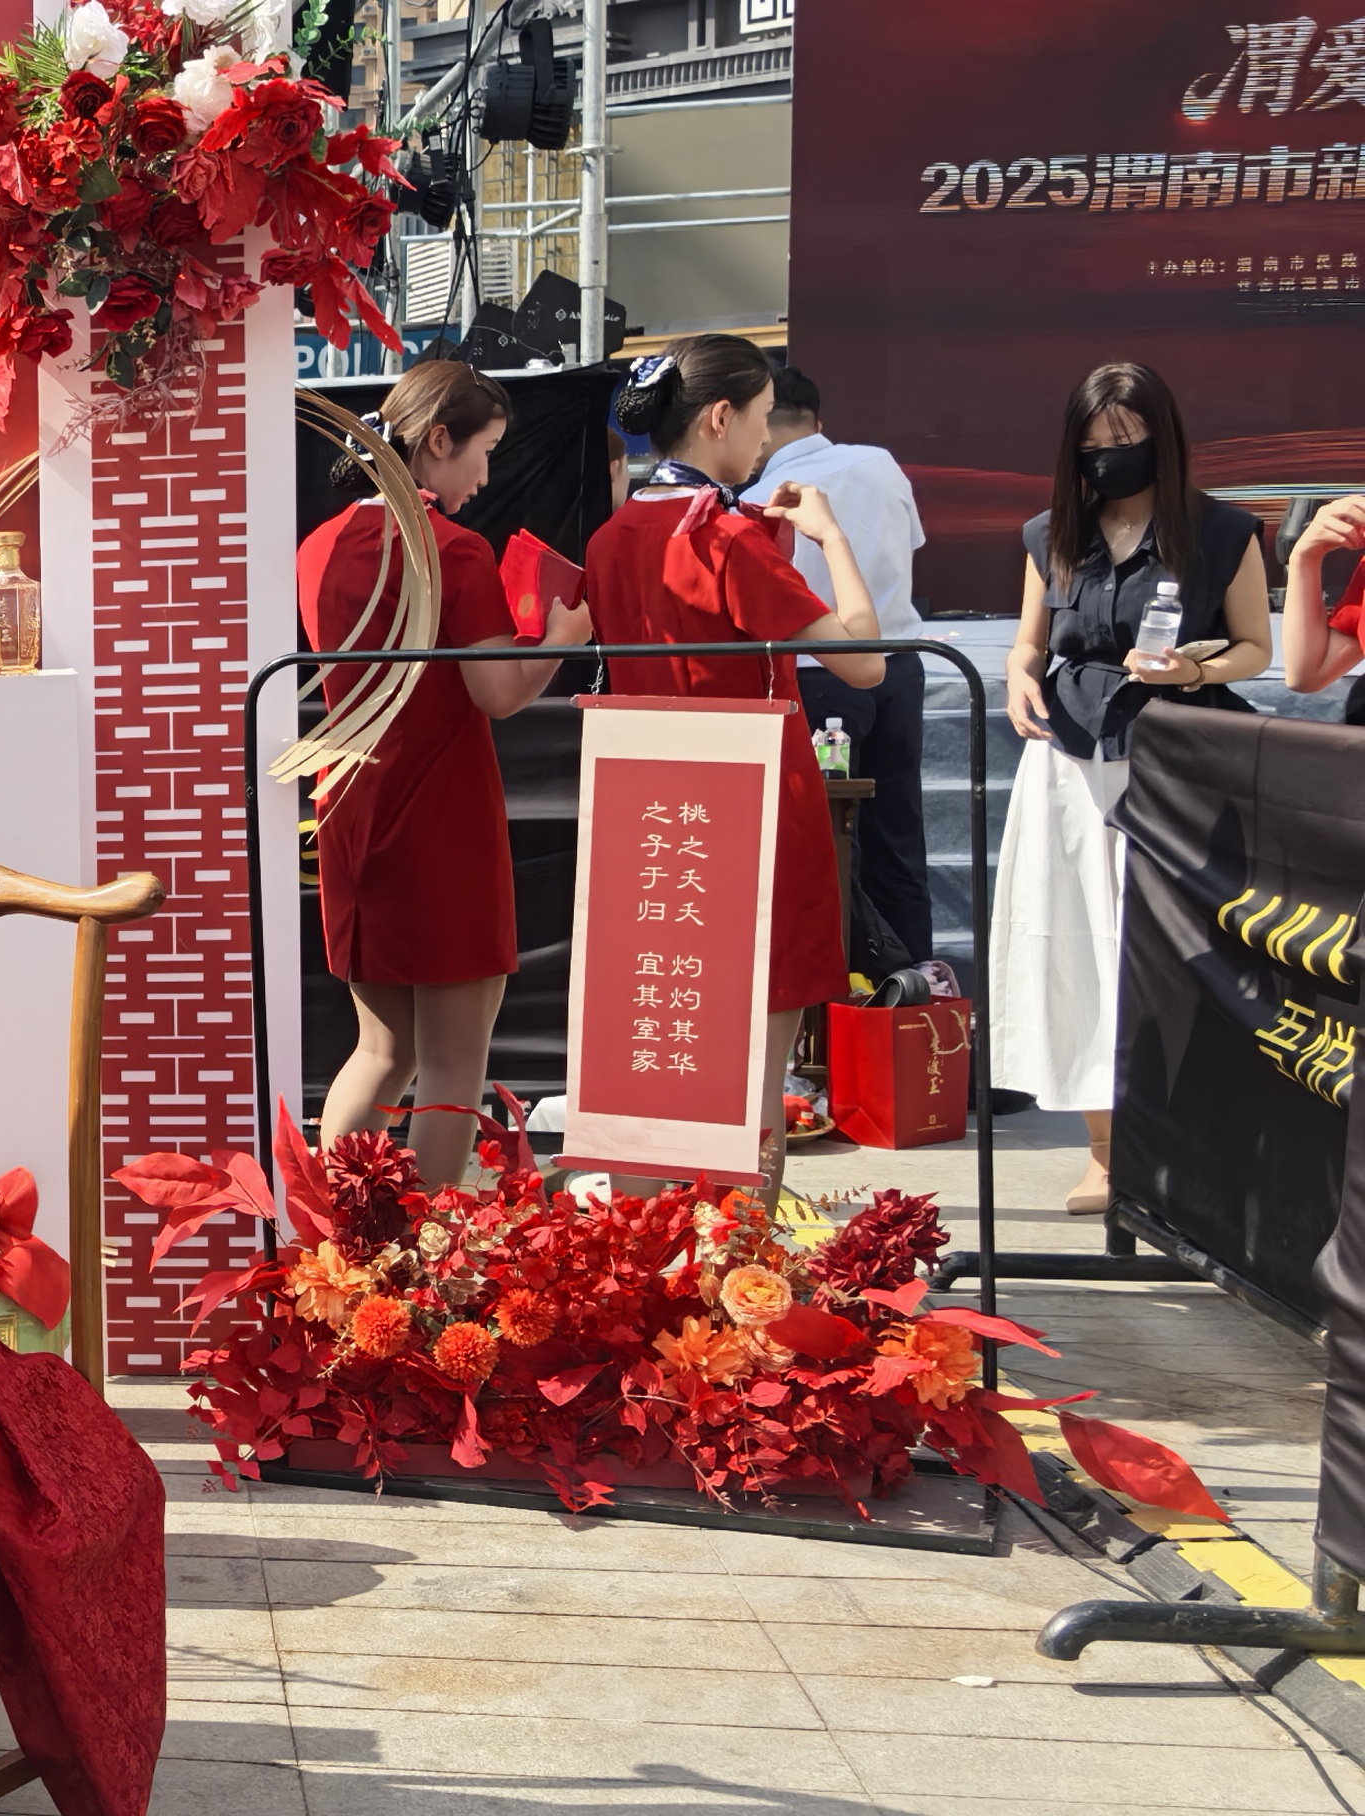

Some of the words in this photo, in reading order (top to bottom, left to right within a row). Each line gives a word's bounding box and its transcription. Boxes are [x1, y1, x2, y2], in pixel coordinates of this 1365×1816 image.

[636, 801, 673, 922] 之子于归
[676, 802, 711, 926] 桃之夭夭
[631, 951, 666, 1073] 宜其室家
[667, 955, 703, 1076] 灼灼其华
